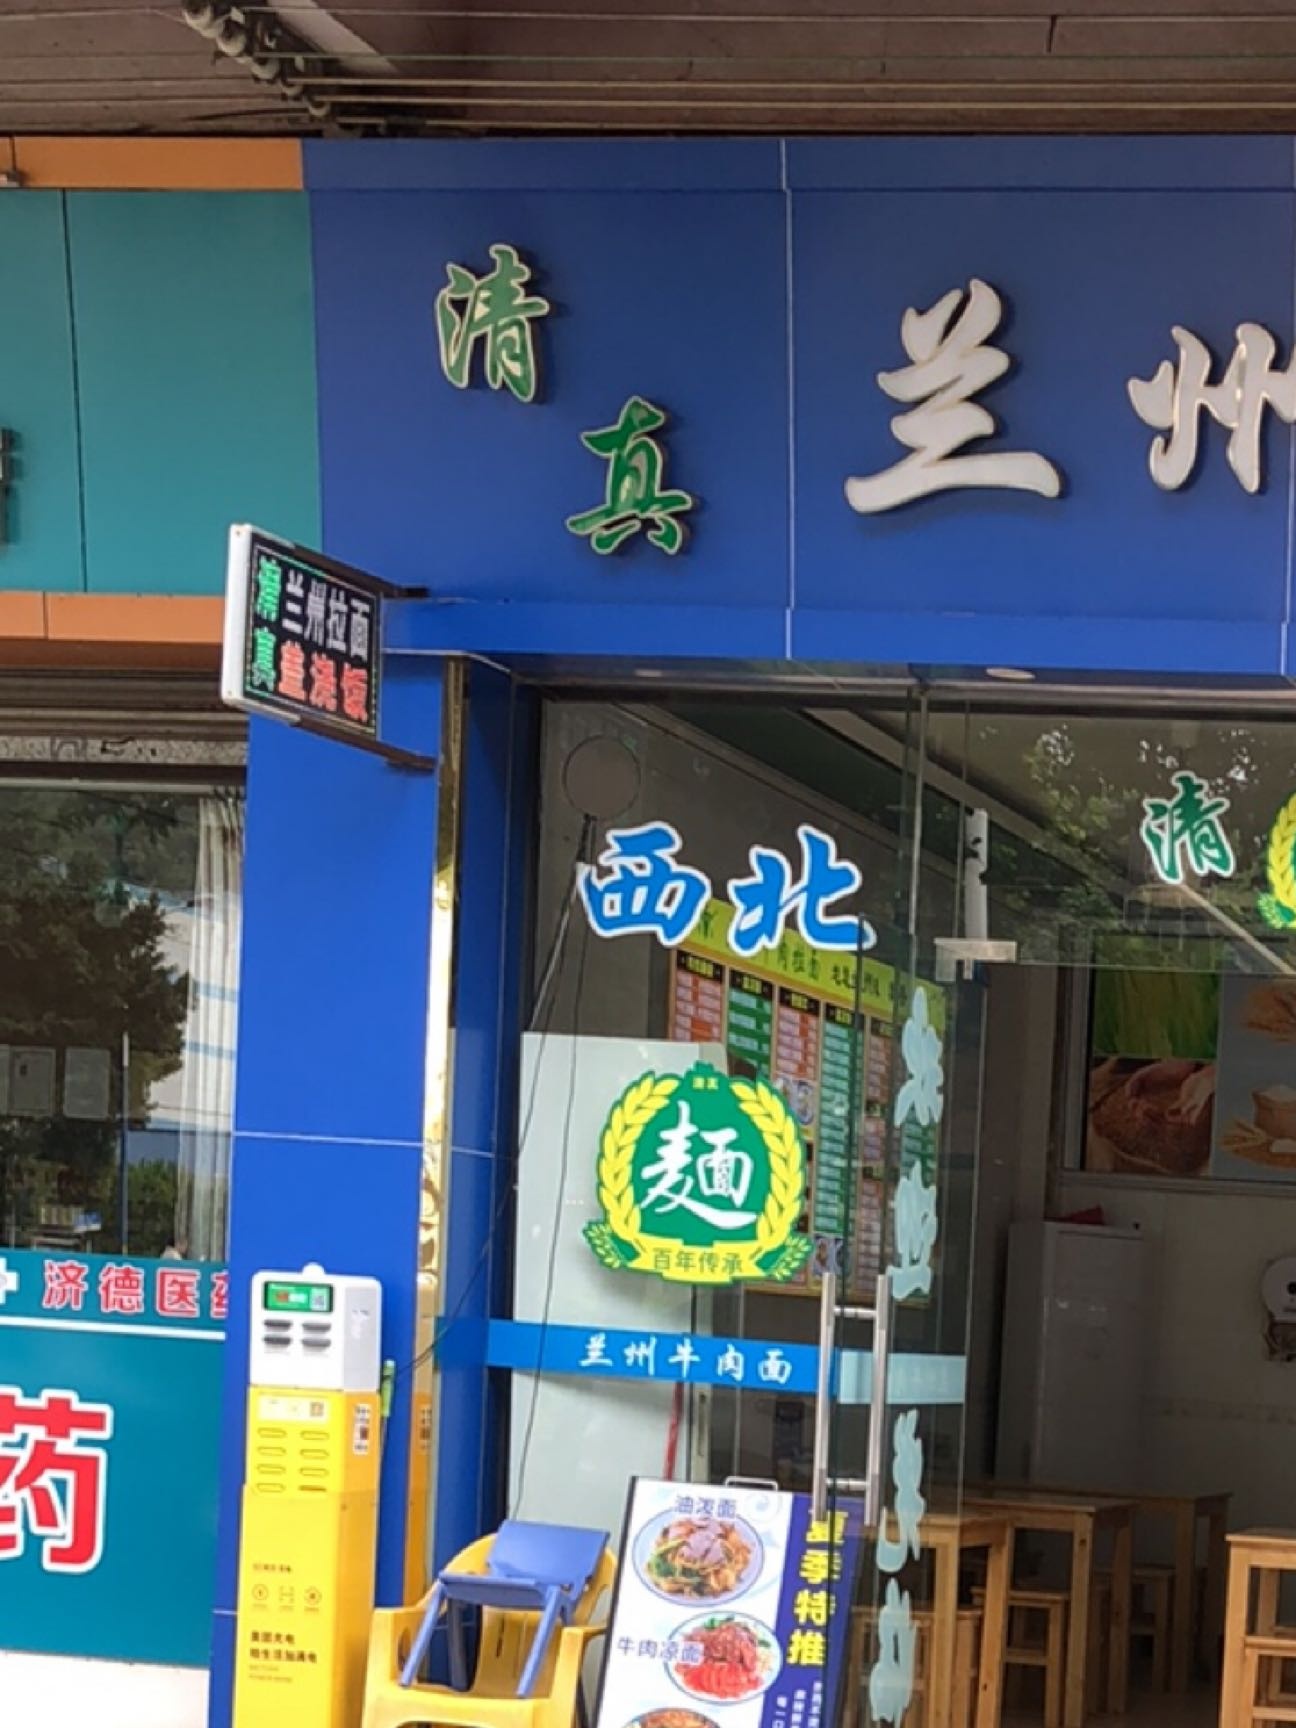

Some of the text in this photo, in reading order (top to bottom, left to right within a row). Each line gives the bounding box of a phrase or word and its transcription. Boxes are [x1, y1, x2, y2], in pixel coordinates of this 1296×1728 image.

[434, 244, 693, 556] 清真
[576, 819, 878, 953] 西北
[652, 1249, 744, 1275] 百年传承
[578, 1331, 794, 1386] 兰州牛肉面
[0, 1385, 113, 1574] 药
